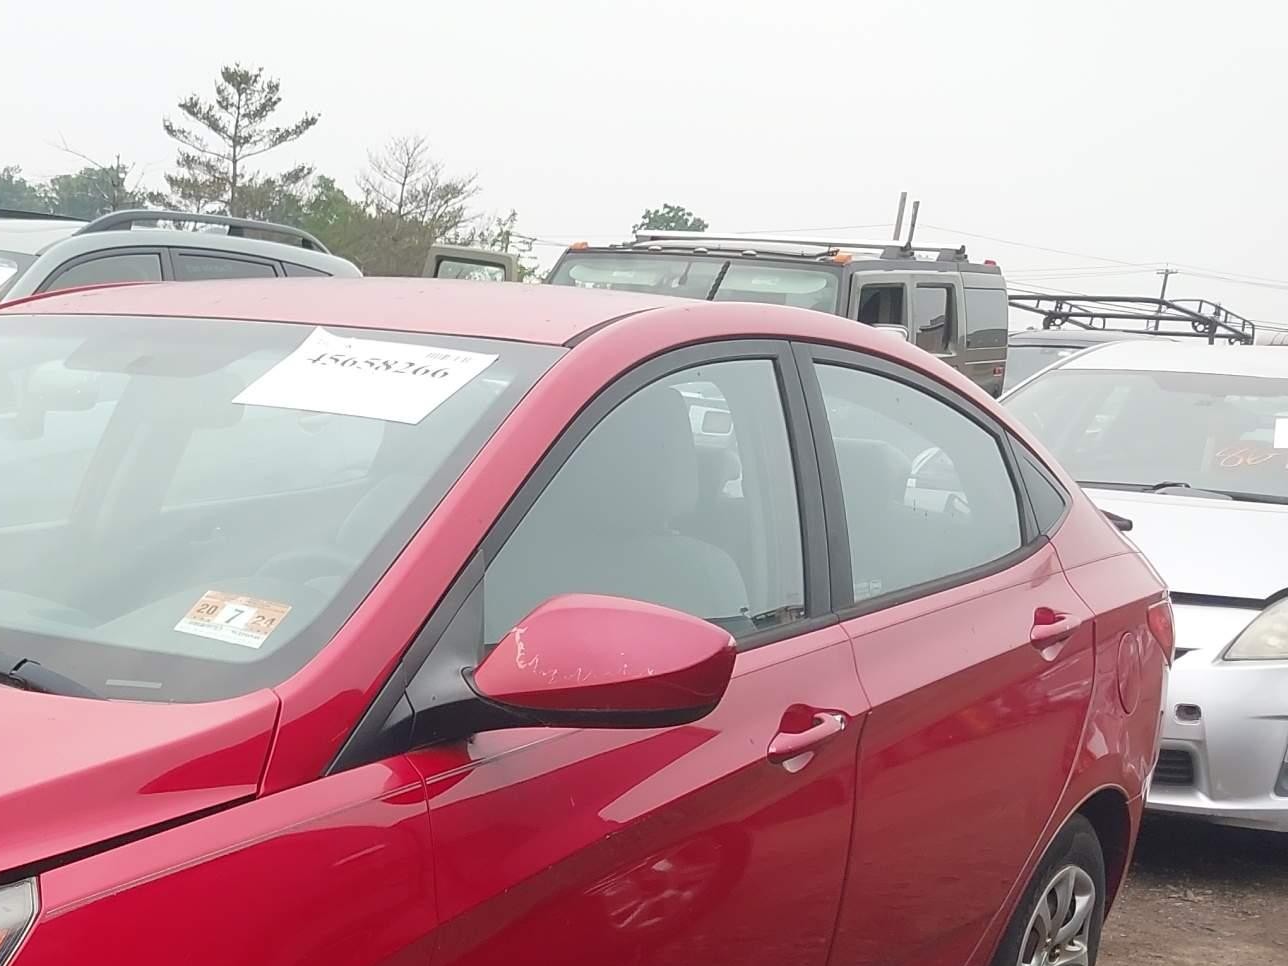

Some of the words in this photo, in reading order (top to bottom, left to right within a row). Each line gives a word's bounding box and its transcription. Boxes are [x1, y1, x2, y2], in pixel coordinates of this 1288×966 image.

[307, 353, 450, 379] 45658266
[196, 603, 219, 616] 20
[225, 608, 246, 624] 7
